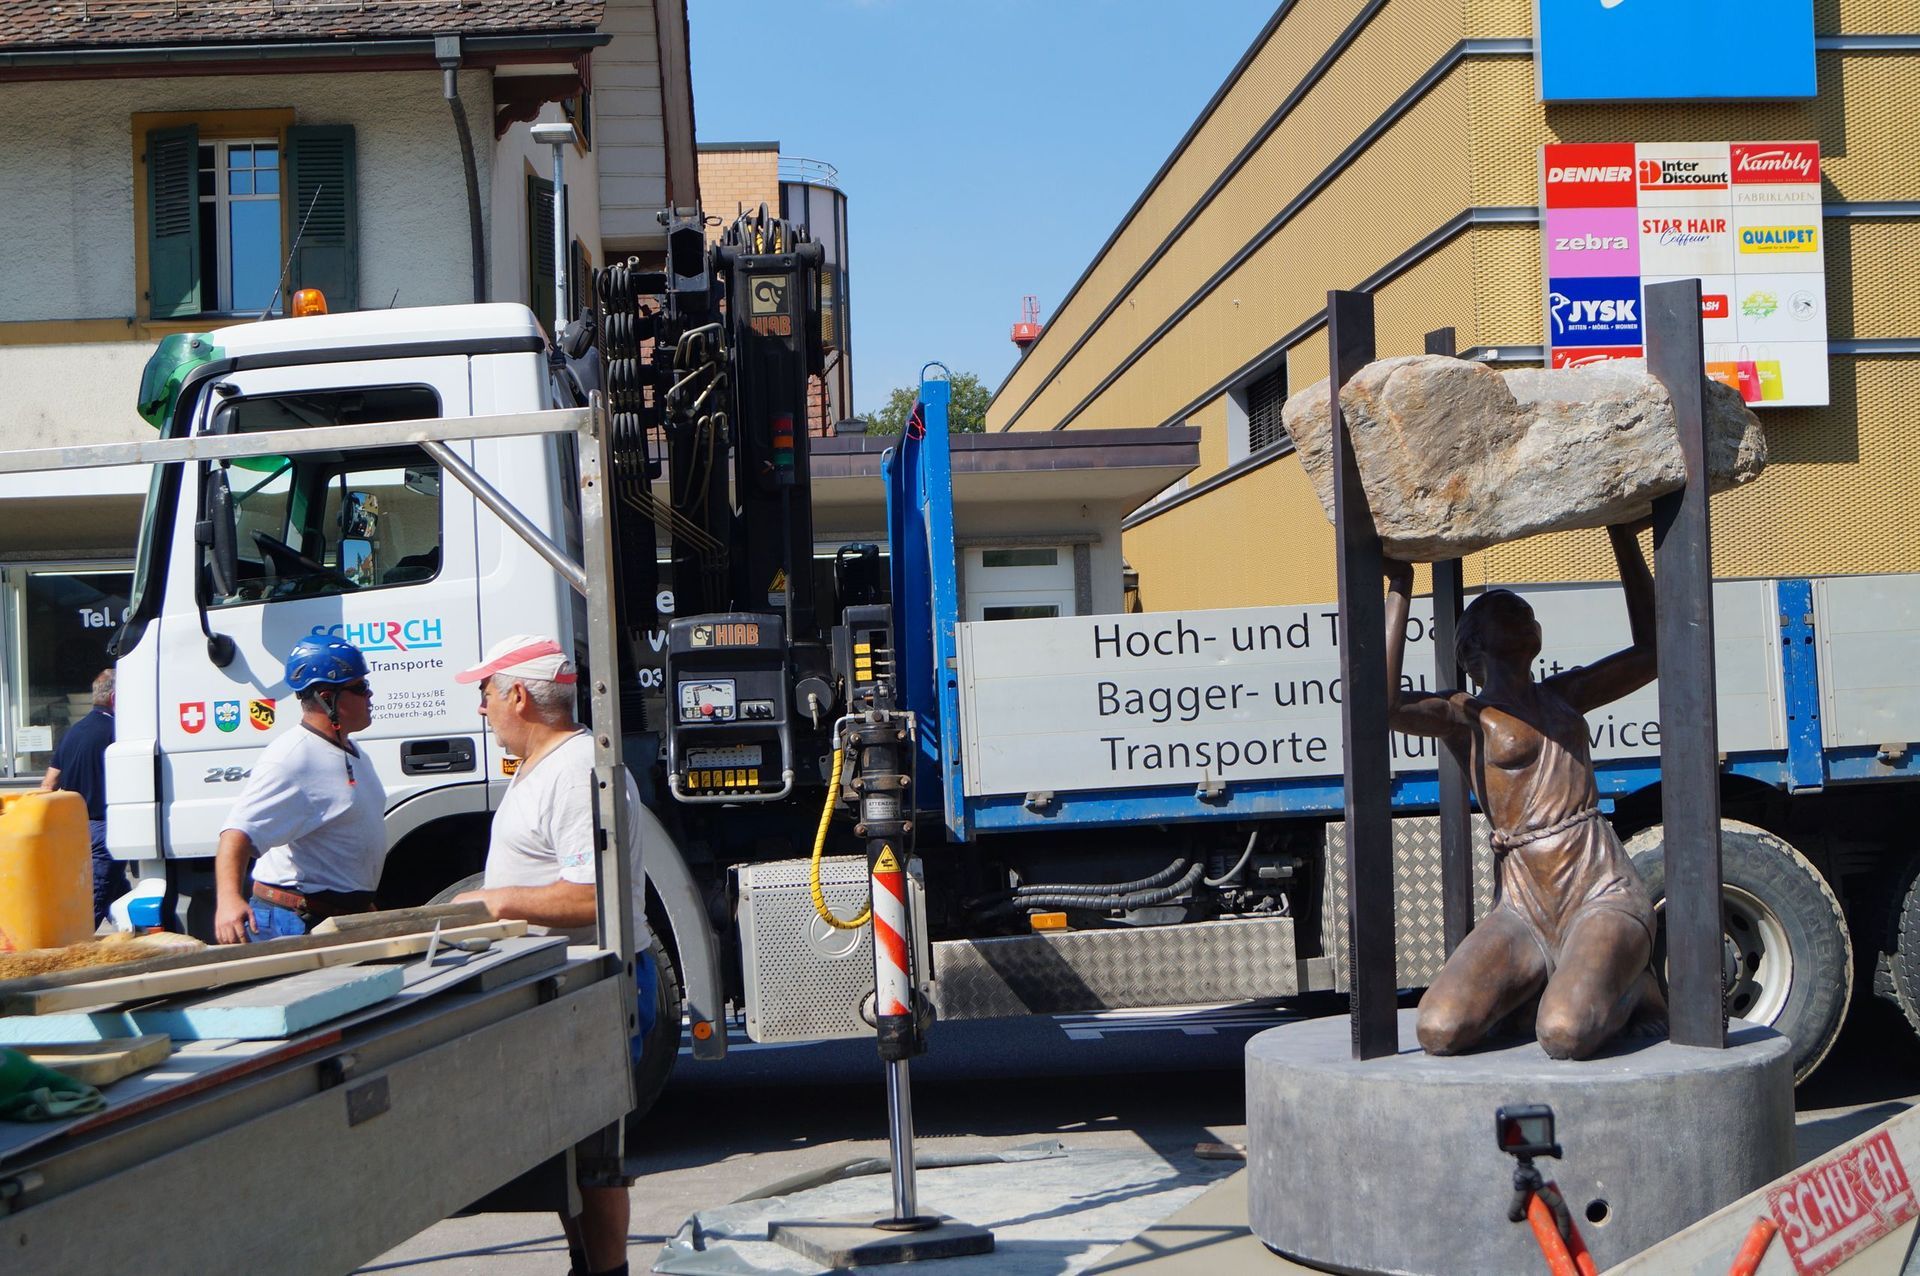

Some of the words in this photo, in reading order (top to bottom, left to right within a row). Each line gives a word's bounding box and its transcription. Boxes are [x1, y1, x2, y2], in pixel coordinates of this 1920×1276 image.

[1662, 160, 1699, 172] Inter
[1737, 150, 1813, 177] Kambly
[1547, 166, 1632, 183] DENNER
[1662, 172, 1729, 184] Discount
[1738, 191, 1815, 203] FABRIKLADEN
[1642, 219, 1682, 234] STAR
[1687, 218, 1727, 233] HAIR
[1555, 233, 1630, 251] zebra
[1742, 229, 1814, 245] QUALIPET
[1568, 299, 1638, 323] JYSK
[752, 315, 791, 337] HIAB
[79, 606, 116, 628] Tel.
[715, 623, 759, 646] HIAB
[1094, 618, 1217, 659] Hoch-
[1231, 612, 1310, 652] und
[370, 658, 443, 672] Transporte
[388, 691, 410, 700] 3250
[411, 689, 446, 700] Lyss/BE
[1097, 681, 1260, 724] Bagger-
[387, 702, 403, 710] 079
[405, 701, 420, 709] 652
[422, 700, 433, 708] 62
[371, 708, 447, 720] w.schuerch-ag.ch
[1100, 731, 1328, 776] Transporte
